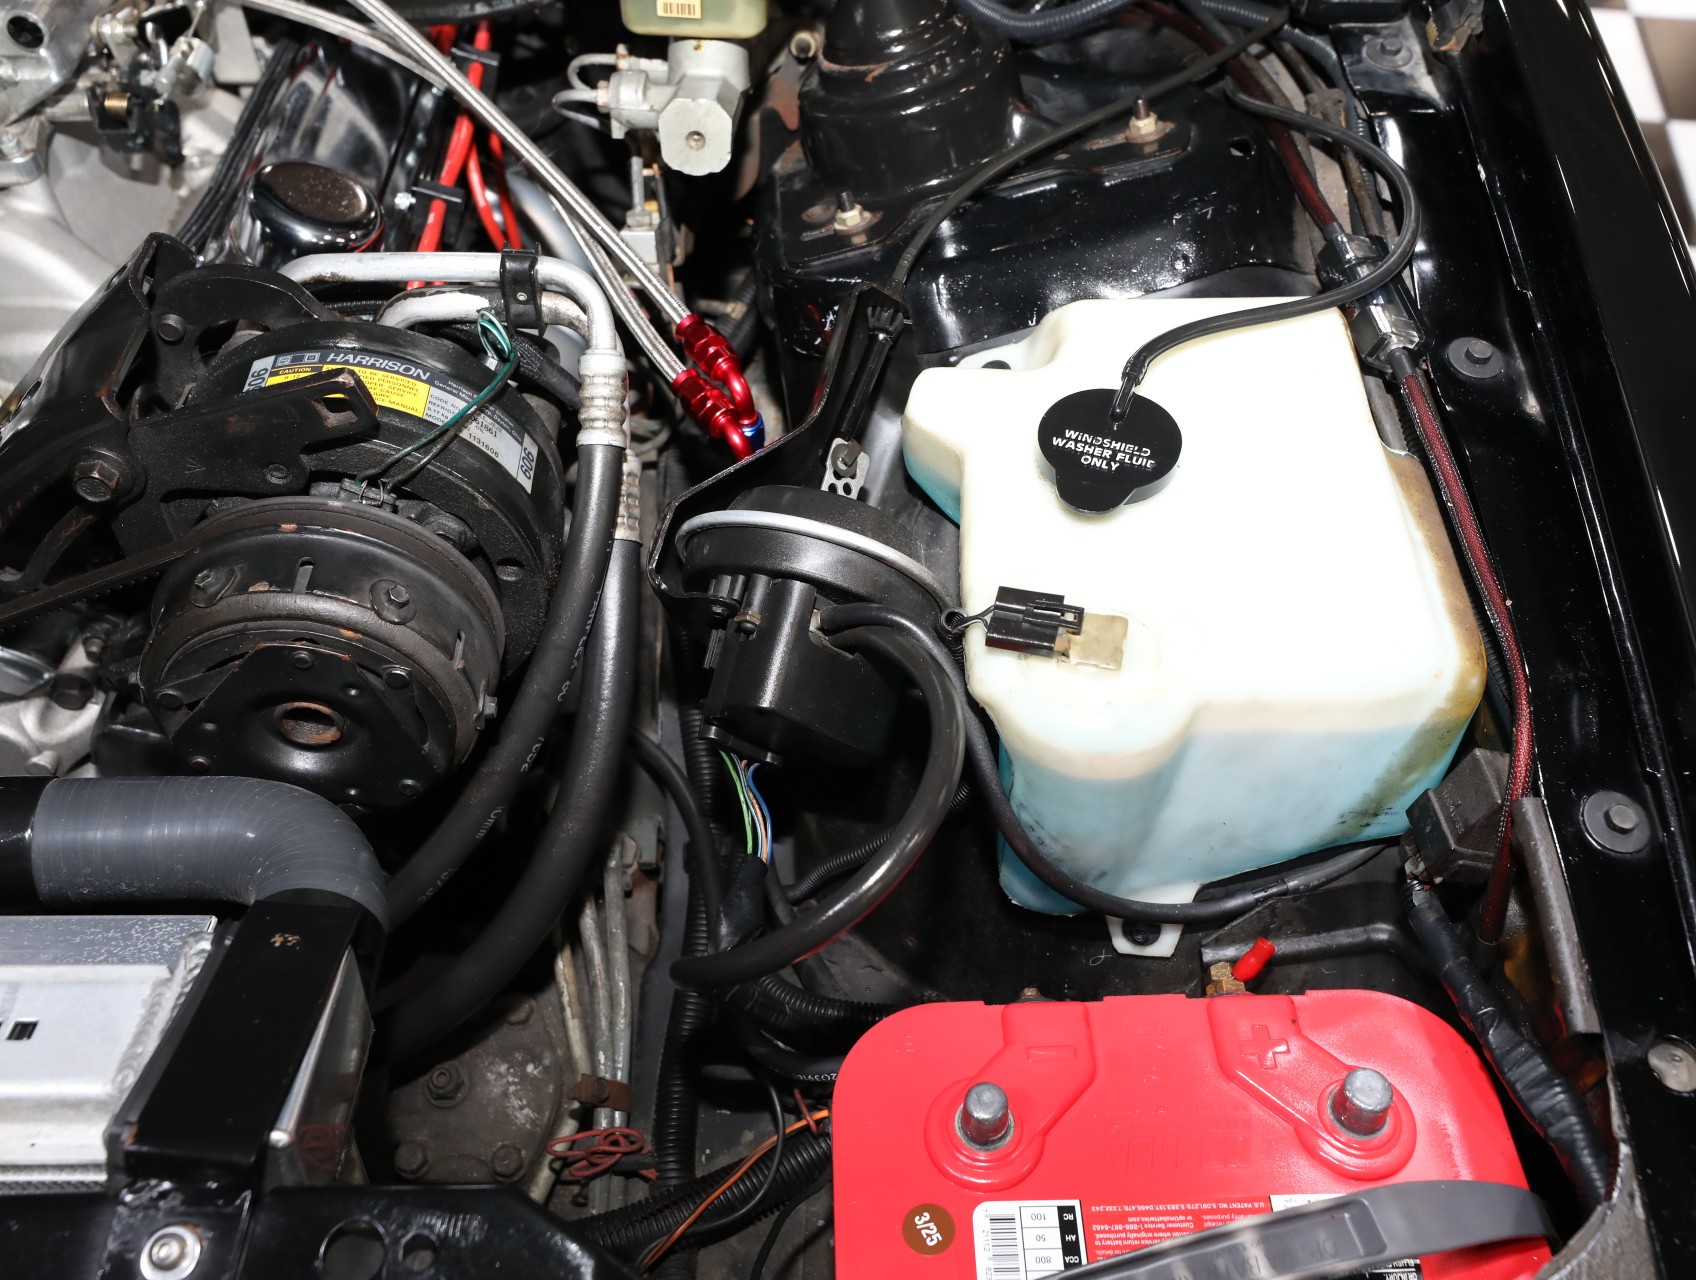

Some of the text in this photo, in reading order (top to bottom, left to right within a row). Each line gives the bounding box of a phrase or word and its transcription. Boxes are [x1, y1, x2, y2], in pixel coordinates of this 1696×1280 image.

[279, 367, 312, 375] CAUTION
[326, 353, 431, 381] HARRISON
[247, 367, 269, 389] 06
[378, 377, 419, 393] PERSONNEL
[381, 373, 417, 387] SERVICED
[380, 389, 405, 398] CAUSE
[388, 385, 417, 398] SERVICE
[434, 380, 458, 394] General
[430, 394, 449, 405] CODE
[389, 400, 422, 414] MANUAL.
[428, 401, 455, 414] REFRIGE
[425, 412, 446, 424] MODE
[1052, 436, 1112, 459] WASHER
[1065, 429, 1151, 457] WINDSHIELD
[520, 446, 535, 481] 606
[1081, 455, 1120, 472] ONLY
[1030, 1212, 1046, 1221] 100
[914, 1211, 943, 1247] 3/25
[1035, 1234, 1077, 1242] AH 50
[1102, 1238, 1122, 1246] battery
[1035, 1255, 1080, 1264] CCA 800
